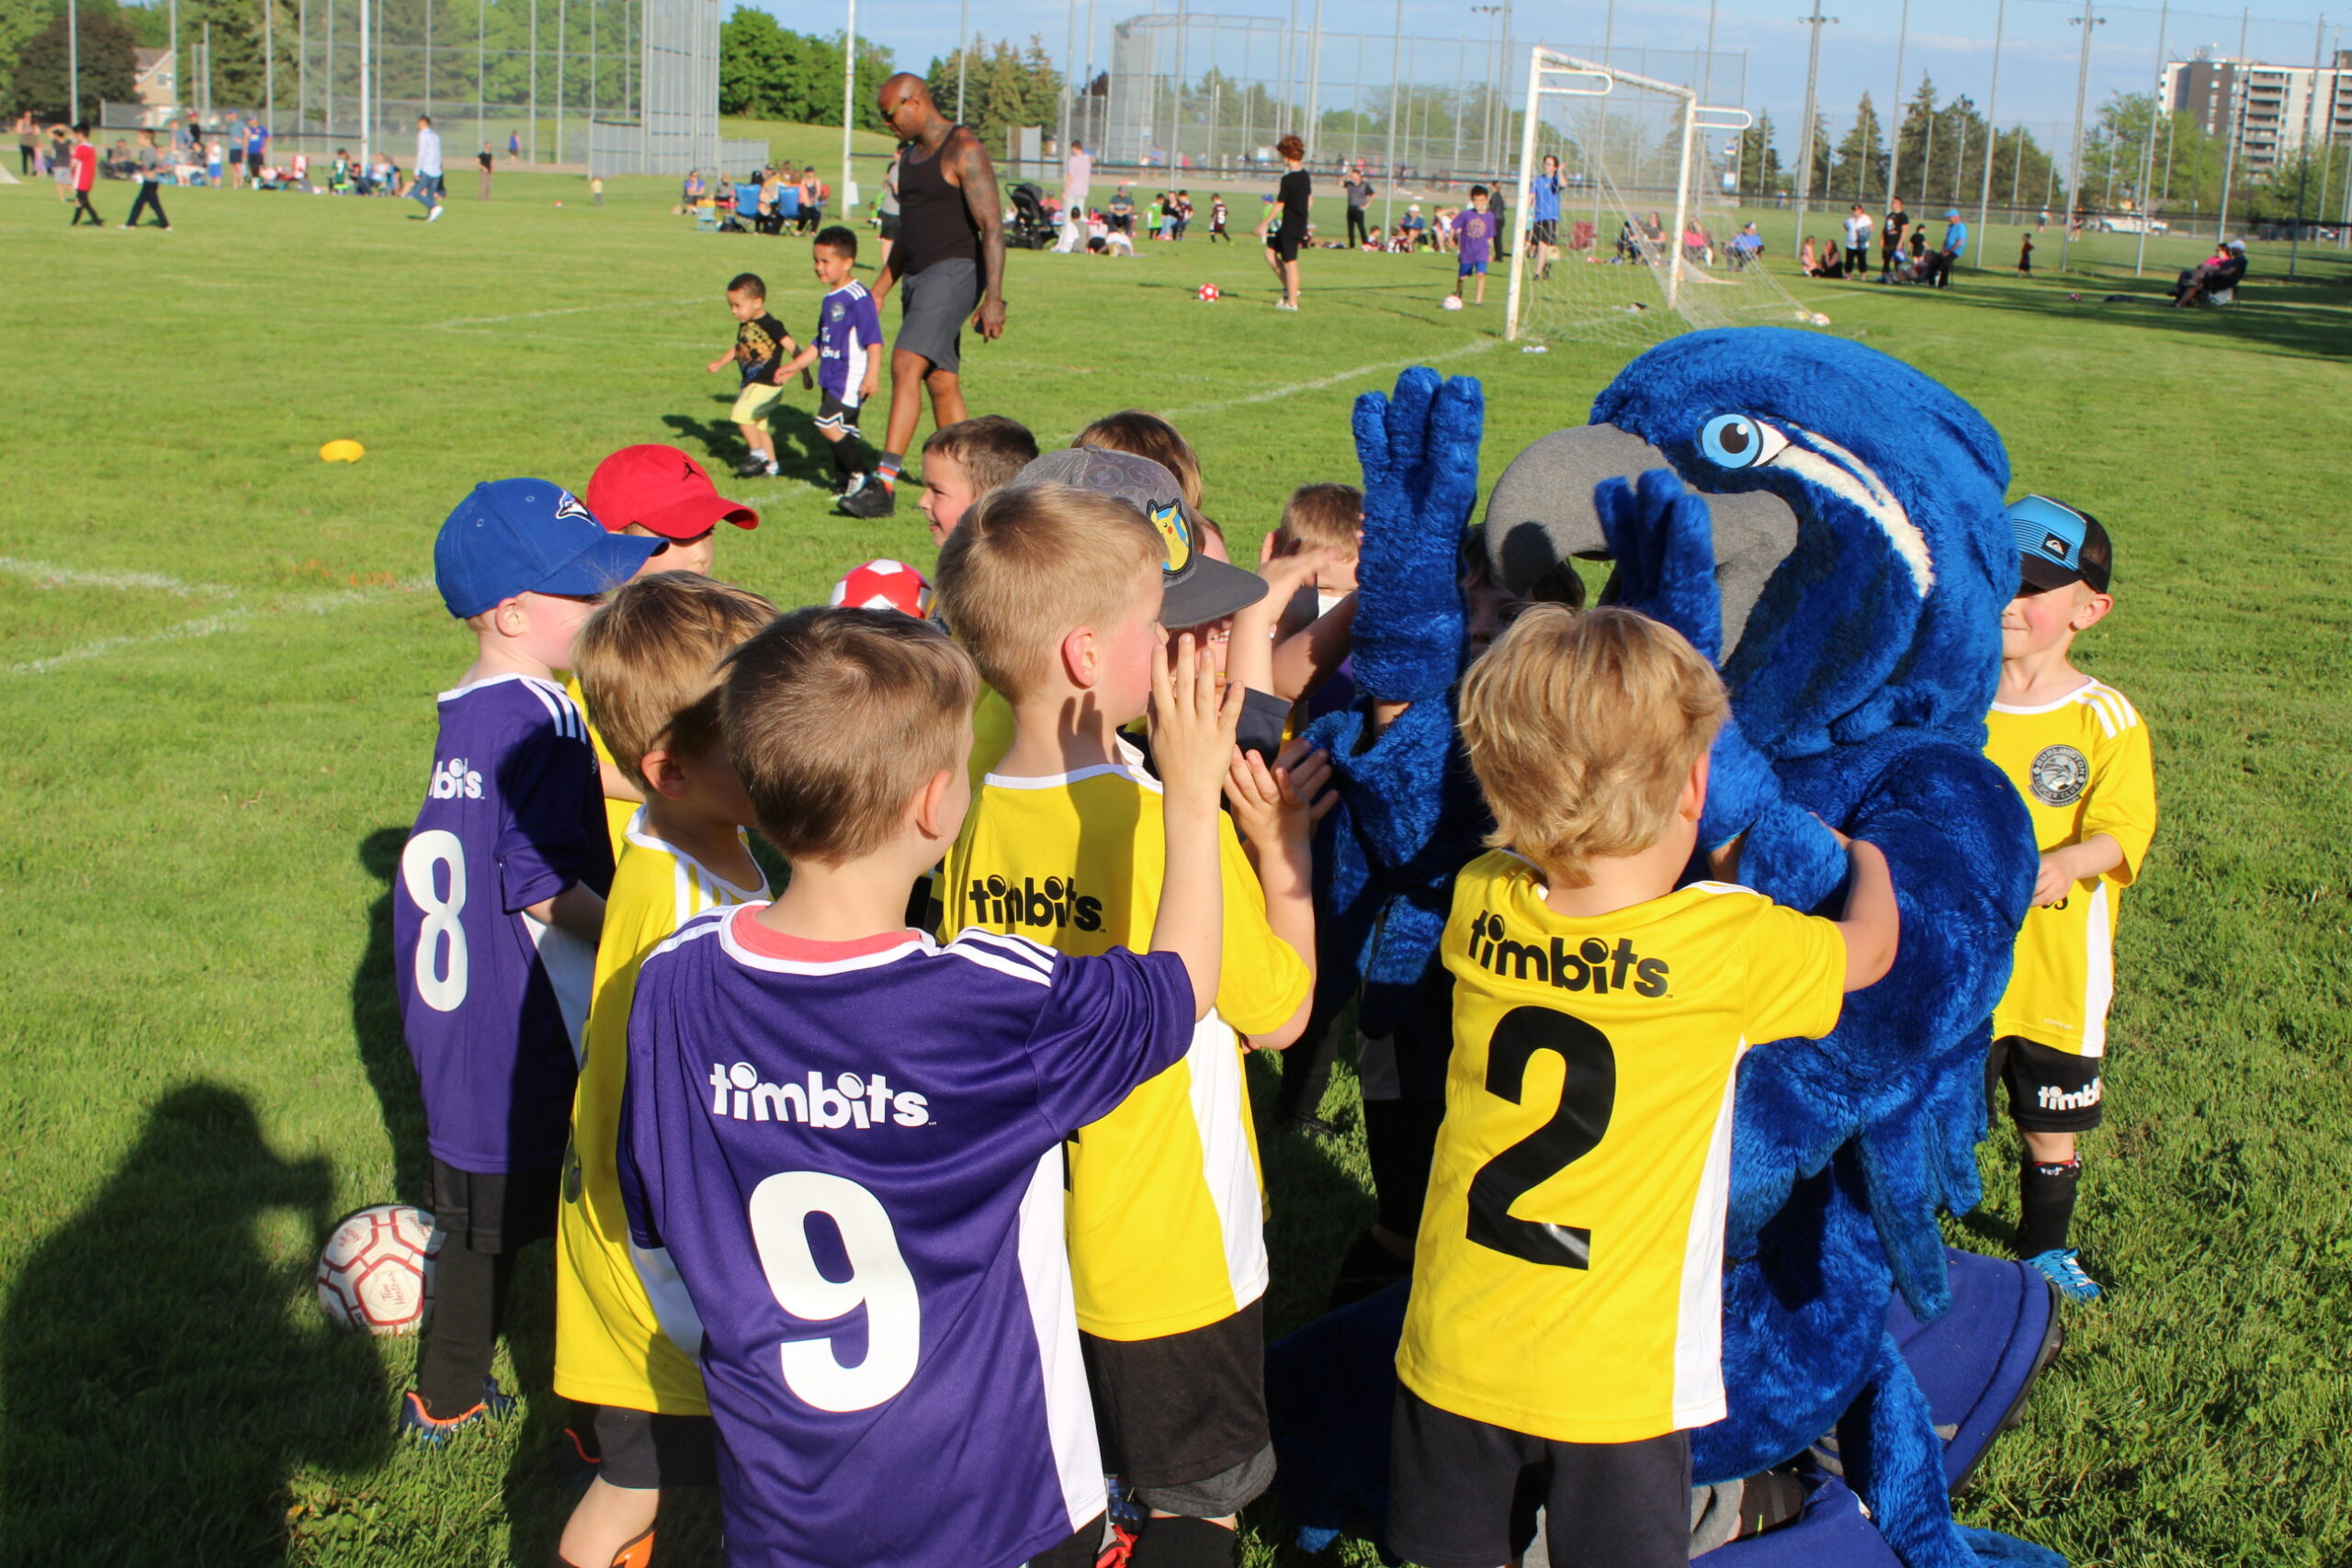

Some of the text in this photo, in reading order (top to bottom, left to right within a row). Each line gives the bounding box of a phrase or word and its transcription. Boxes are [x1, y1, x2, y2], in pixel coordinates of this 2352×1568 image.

[2035, 748, 2086, 774] BURLINGTON
[2060, 784, 2080, 797] CLUB
[401, 829, 469, 1011] 8
[968, 874, 1102, 932] timbits
[1468, 909, 1669, 998] timbits
[709, 1062, 931, 1129] timbits
[1465, 1006, 1616, 1270] 2
[749, 1171, 921, 1412] 9
